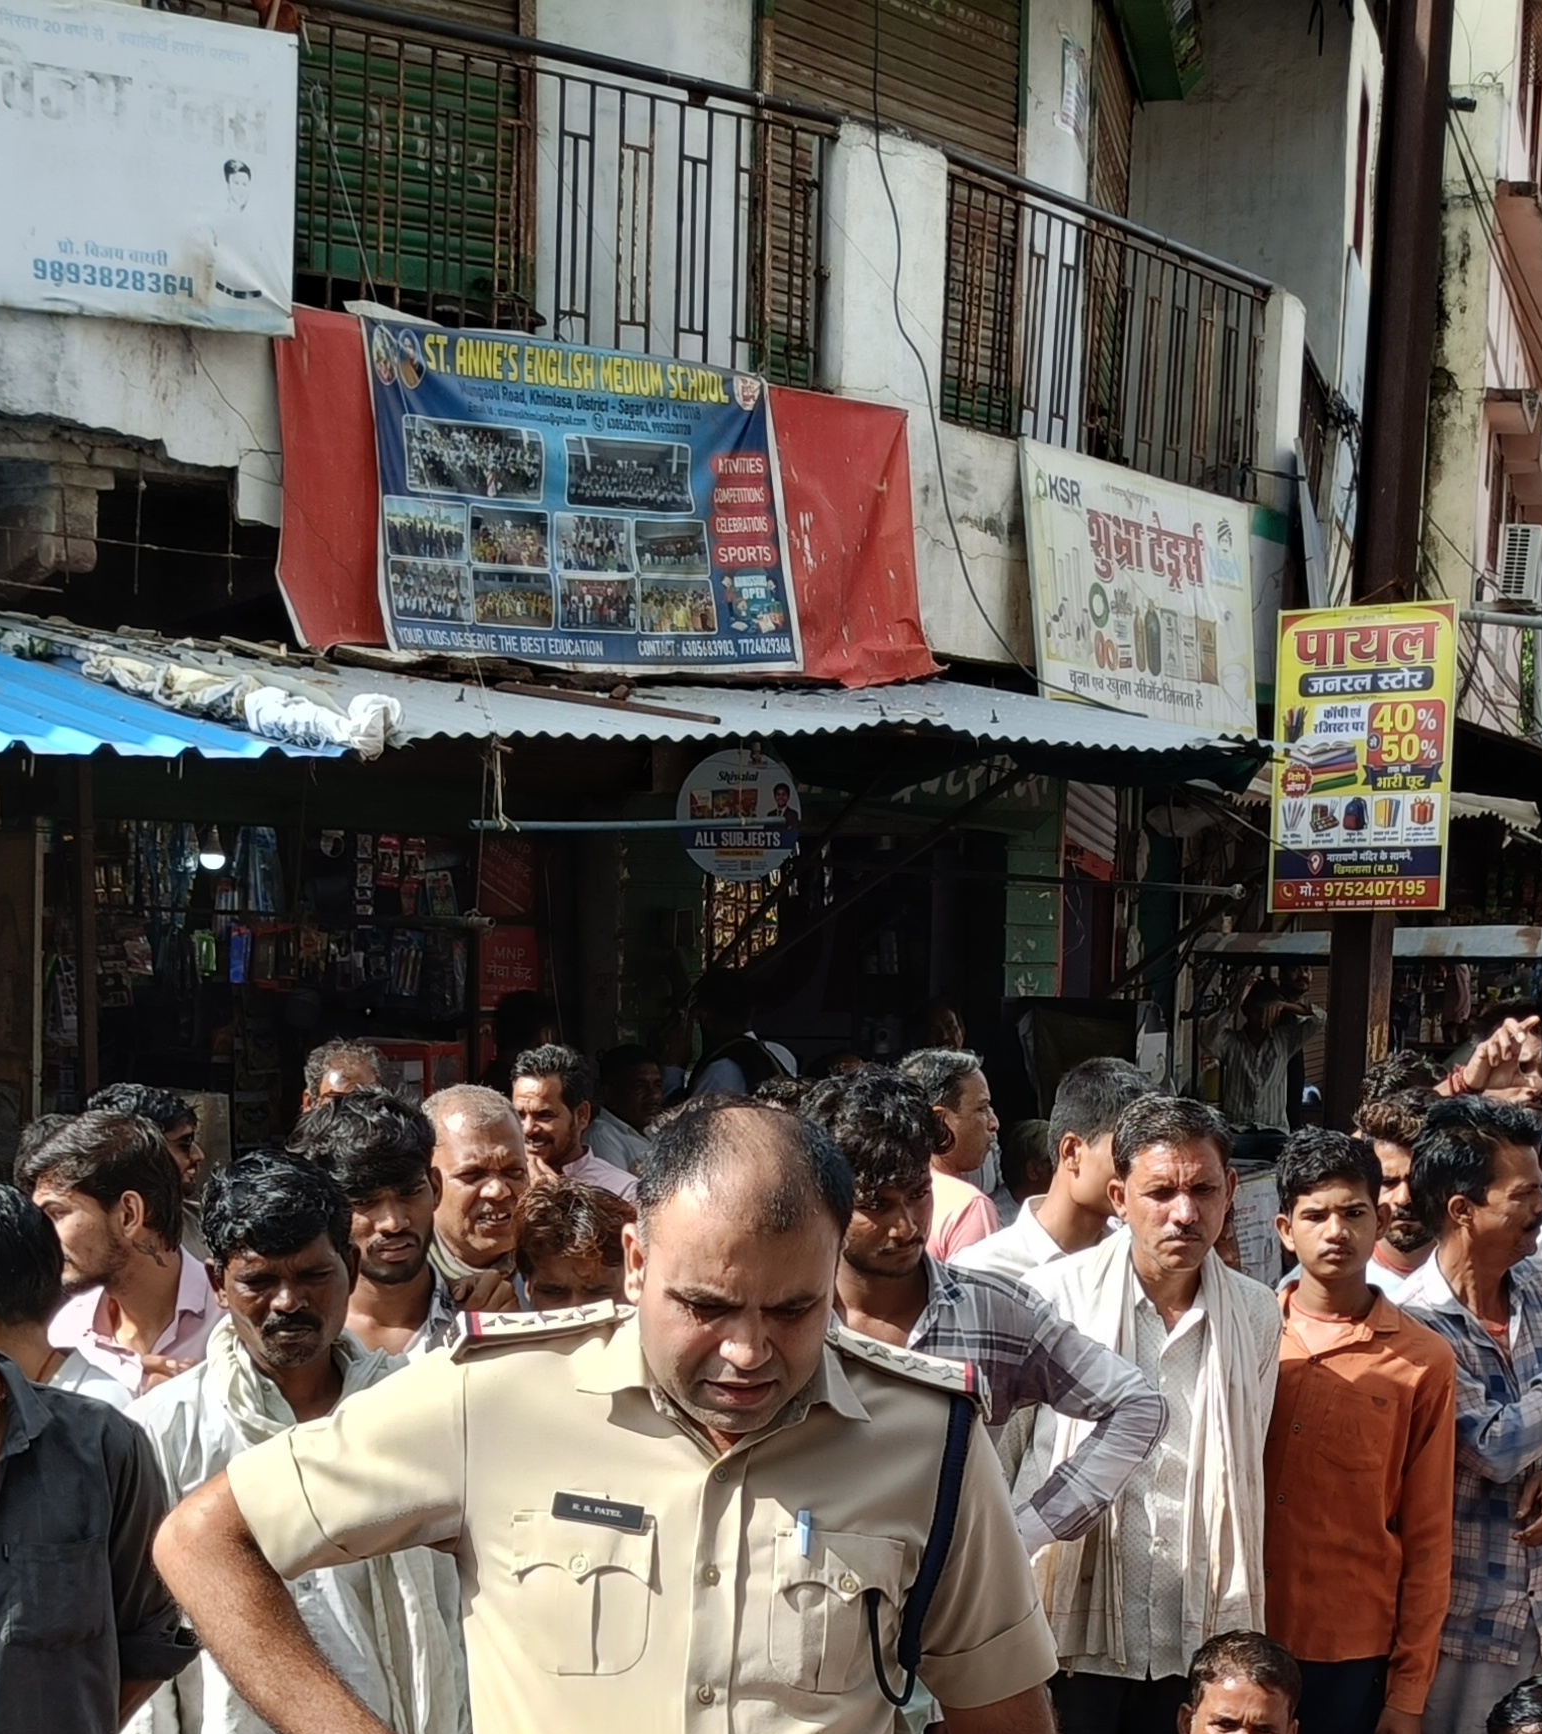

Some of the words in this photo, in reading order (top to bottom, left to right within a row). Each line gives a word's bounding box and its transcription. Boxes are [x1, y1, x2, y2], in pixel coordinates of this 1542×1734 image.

[44, 20, 63, 35] 20
[84, 239, 125, 261] विजय
[32, 257, 194, 298] 9893828364
[423, 333, 451, 375] ST.
[455, 337, 520, 382] ANNE'S
[524, 345, 593, 390] ENGLISH
[598, 354, 663, 398] MEDIUM
[667, 364, 730, 405] SCHOOL
[501, 386, 528, 406] Road,
[529, 387, 575, 412] Khimlasa,
[576, 394, 609, 413] District
[617, 397, 644, 418] Sagar
[713, 486, 766, 505] COMPETITIONS
[1047, 473, 1083, 508] KSR
[715, 515, 769, 534] CELEBRATIONS
[718, 545, 772, 563] SPORTS
[741, 586, 767, 600] OPEN
[395, 626, 425, 647] YOUR
[426, 629, 451, 648] KIDS
[452, 632, 497, 652] DESERVE
[498, 635, 519, 654] THE
[520, 636, 547, 655] BEST
[547, 637, 605, 658] EDUCATION
[637, 639, 676, 658] CONTACT
[681, 638, 738, 658] 6305683903,
[738, 637, 792, 655] 7724829368
[1293, 621, 1441, 670] पायल
[1068, 668, 1090, 694] चूना
[1105, 676, 1133, 701] खुला
[1195, 688, 1204, 711] है
[1308, 673, 1373, 694] जनरल
[1377, 667, 1425, 690] स्टोर
[1323, 705, 1348, 719] कॉपी
[1350, 703, 1362, 718] एवं
[1372, 702, 1437, 733] 40%
[1313, 720, 1350, 734] रजिस्टर
[1351, 719, 1366, 732] पर
[1380, 733, 1438, 763] 50%
[1376, 774, 1405, 788] भारी
[1405, 774, 1426, 790] छूट
[694, 831, 718, 847] ALL
[720, 831, 781, 848] SUBJECTS
[1359, 850, 1379, 862] मंदिर
[1379, 850, 1388, 862] के
[1333, 863, 1372, 875] खिमलासा
[1323, 880, 1427, 898] 9752407195
[493, 946, 526, 961] MNP
[486, 959, 510, 978] सेवा
[512, 961, 533, 981] केंद्र
[594, 1506, 623, 1518] PATEL
